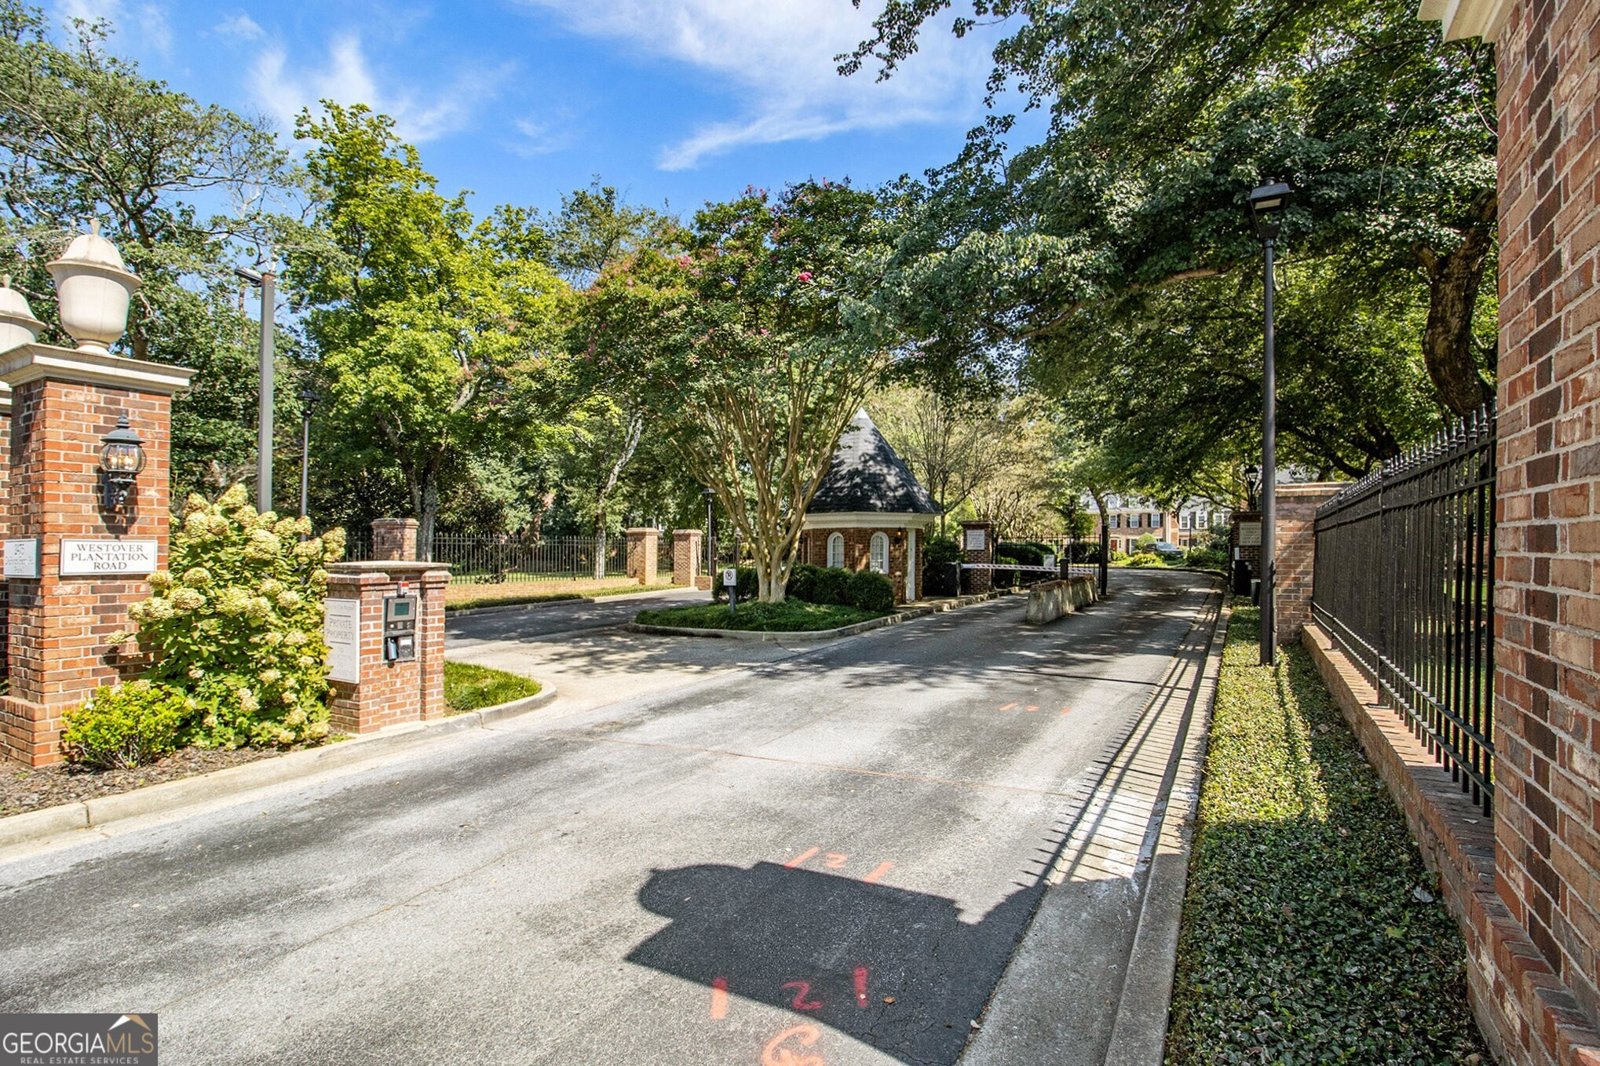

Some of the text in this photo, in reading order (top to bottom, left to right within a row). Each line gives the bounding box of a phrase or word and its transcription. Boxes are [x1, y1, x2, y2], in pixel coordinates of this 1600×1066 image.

[77, 543, 144, 553] WESTOVER
[70, 552, 148, 562] PLANTATION
[93, 561, 127, 570] ROAD
